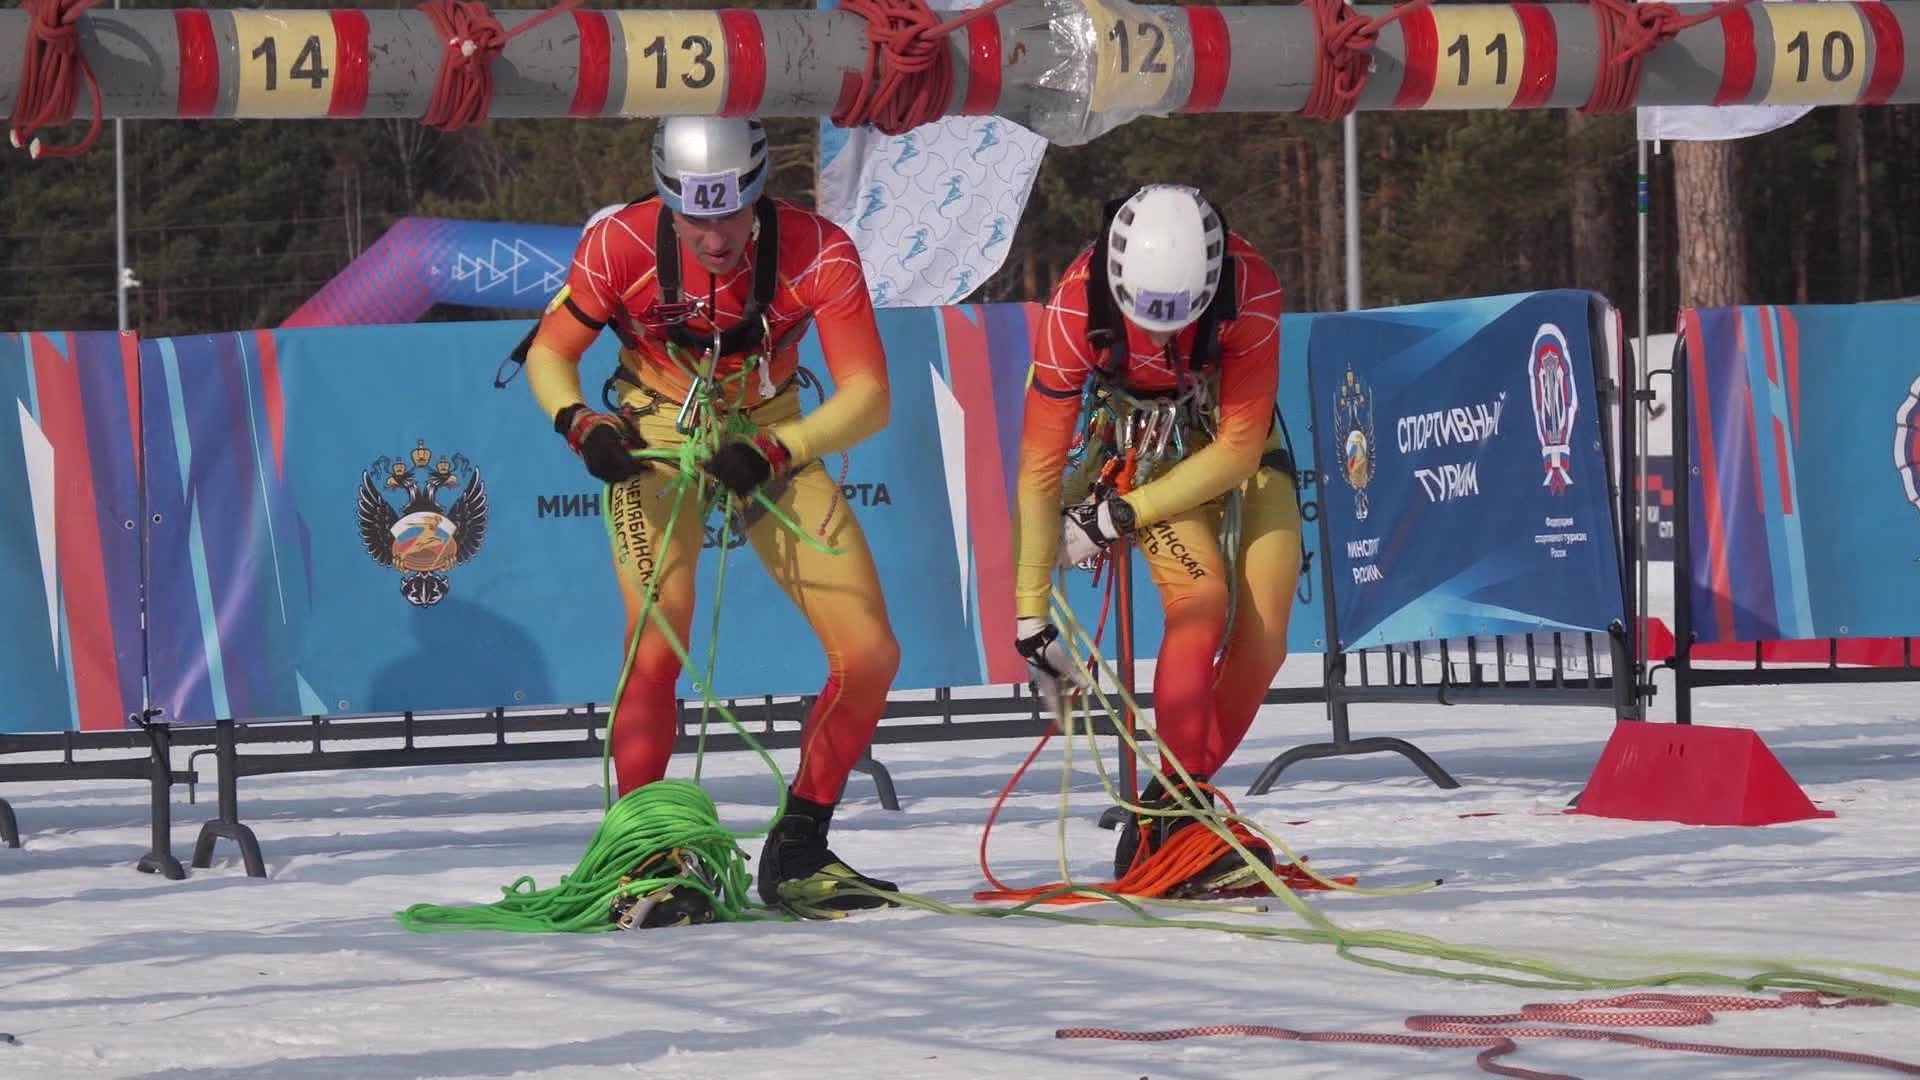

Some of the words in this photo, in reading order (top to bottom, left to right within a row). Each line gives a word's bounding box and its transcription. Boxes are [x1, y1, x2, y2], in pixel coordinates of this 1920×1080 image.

[252, 35, 329, 91] 14
[643, 35, 717, 90] 13
[1107, 22, 1168, 74] 12
[1447, 33, 1508, 87] 11
[1786, 31, 1855, 83] 10
[694, 183, 727, 209] 42
[1147, 298, 1176, 321] 41
[537, 493, 601, 519] МИН
[626, 479, 661, 603] ЧЕЛЯБИНСК
[1152, 519, 1207, 580] ИНСКАЯ
